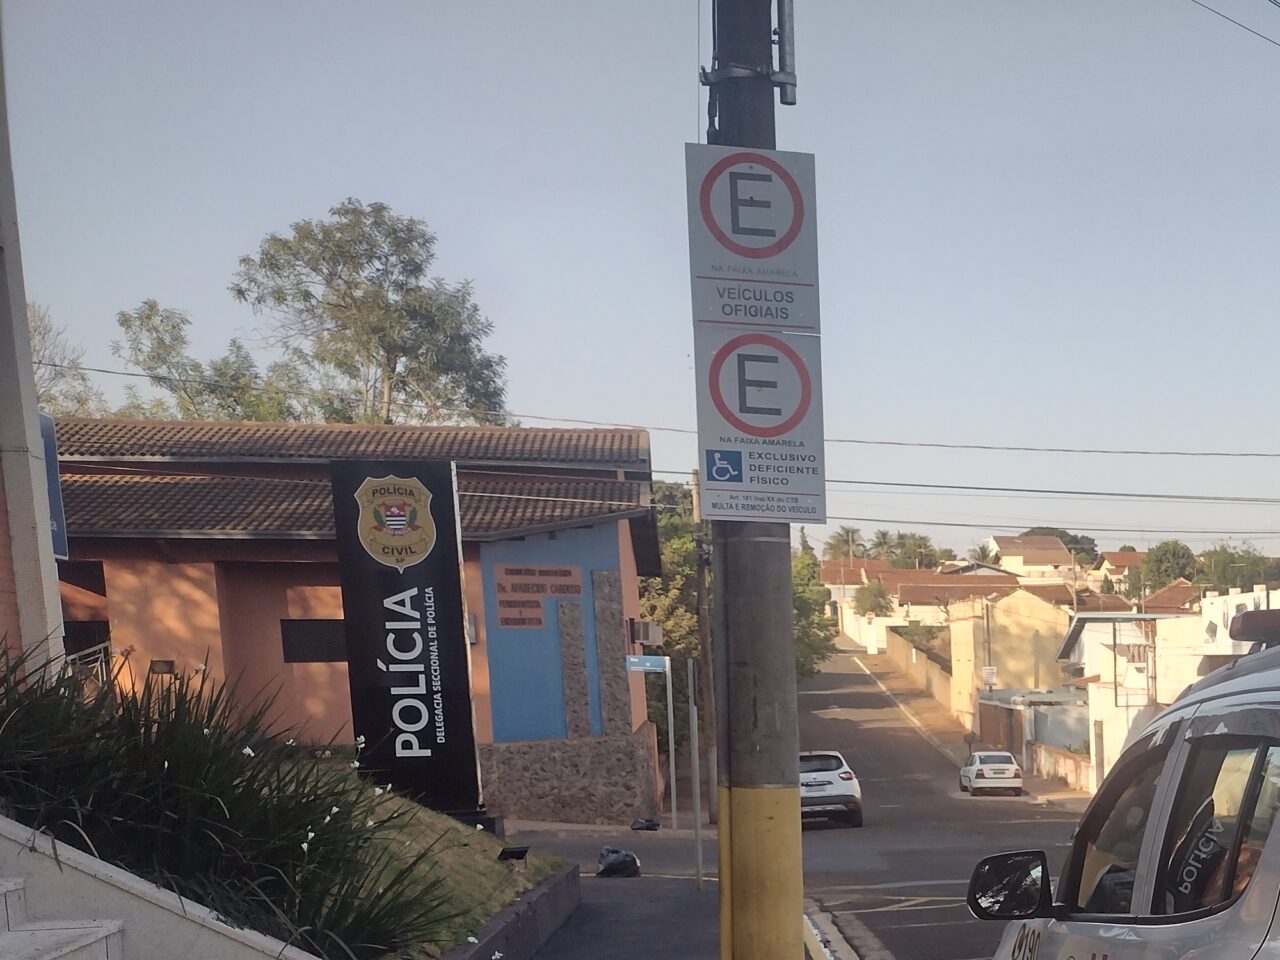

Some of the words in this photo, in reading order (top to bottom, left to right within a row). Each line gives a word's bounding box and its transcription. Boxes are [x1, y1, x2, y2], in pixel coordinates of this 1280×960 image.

[729, 171, 777, 238] E
[716, 284, 795, 304] VEÍCULOS
[737, 353, 782, 417] E
[719, 436, 731, 444] NA
[734, 437, 760, 445] FAIXA
[762, 439, 805, 448] AMARELA
[748, 451, 817, 463] EXCLUSIVO
[749, 463, 819, 475] DEFICIENTE
[749, 475, 789, 486] FÍSICO
[372, 485, 416, 498] POLÍCIA
[711, 502, 734, 511] MULTA
[741, 503, 775, 513] REMOÇÃO
[382, 546, 417, 556] CIVIL
[424, 586, 436, 624] POLÍCIA
[427, 625, 437, 638] DE
[377, 586, 432, 757] POLÍCIA
[428, 639, 442, 691] SECCIONAL
[432, 693, 446, 744] DELEGACIA
